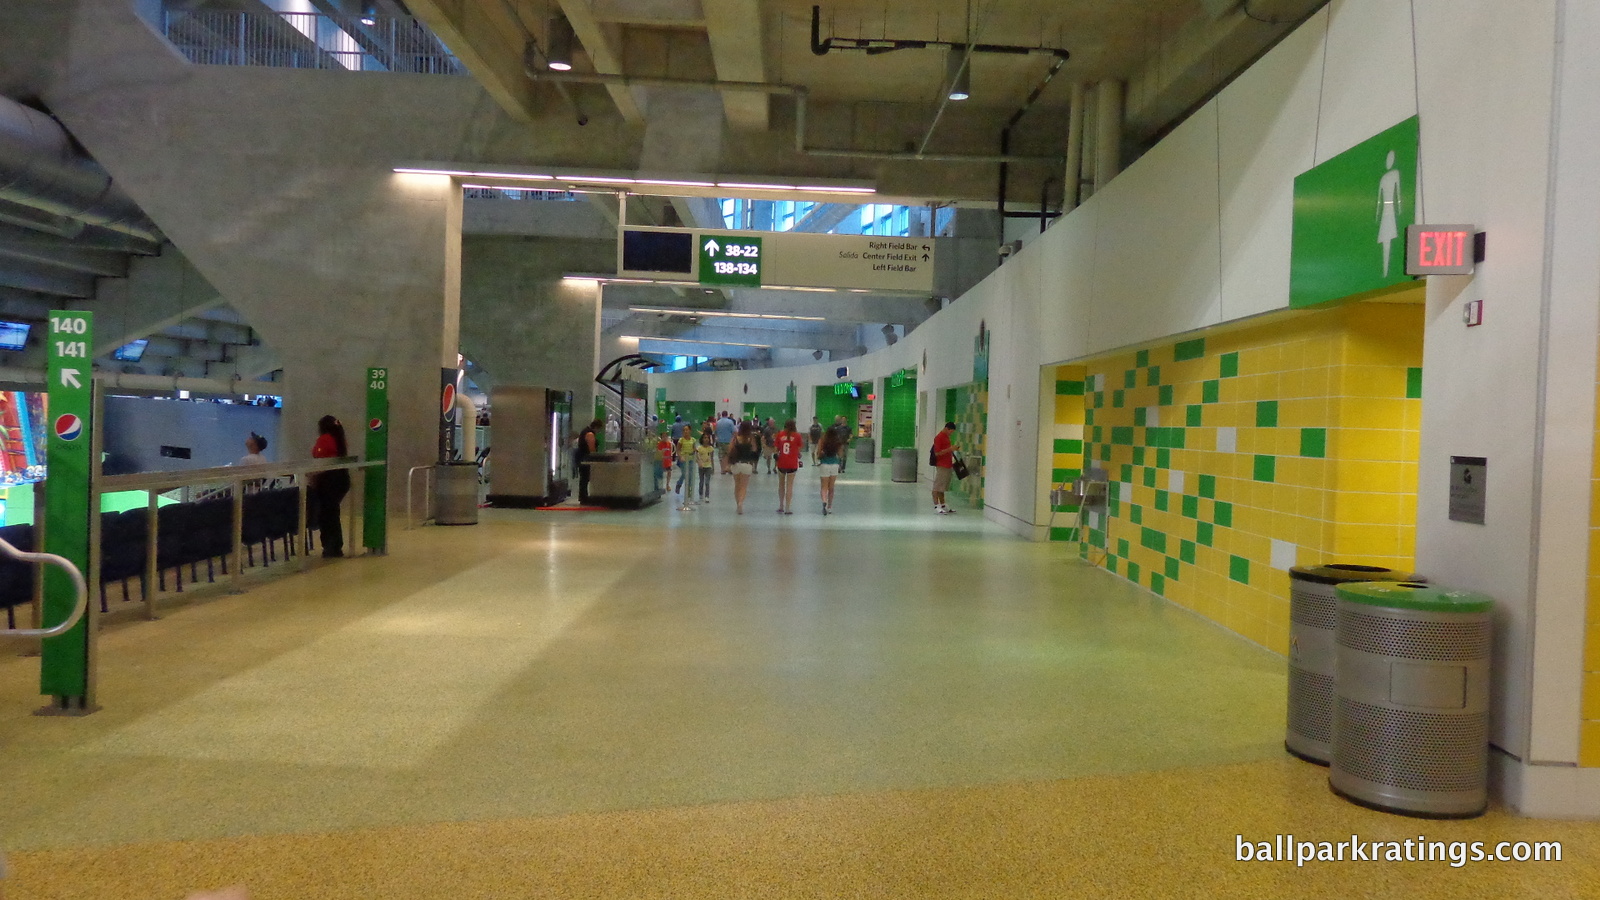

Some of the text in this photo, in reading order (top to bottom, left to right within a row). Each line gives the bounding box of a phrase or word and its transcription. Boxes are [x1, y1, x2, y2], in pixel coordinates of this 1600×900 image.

[725, 244, 758, 257] 38-22
[869, 241, 918, 251] Right Field Bar
[1419, 231, 1467, 266] EXIT
[839, 251, 917, 262] Salida Center Field Exit
[713, 261, 758, 275] 138-134
[887, 264, 903, 272] Field
[50, 317, 87, 335] 140
[56, 341, 87, 358] 141
[372, 369, 385, 379] 39
[370, 380, 384, 389] 40
